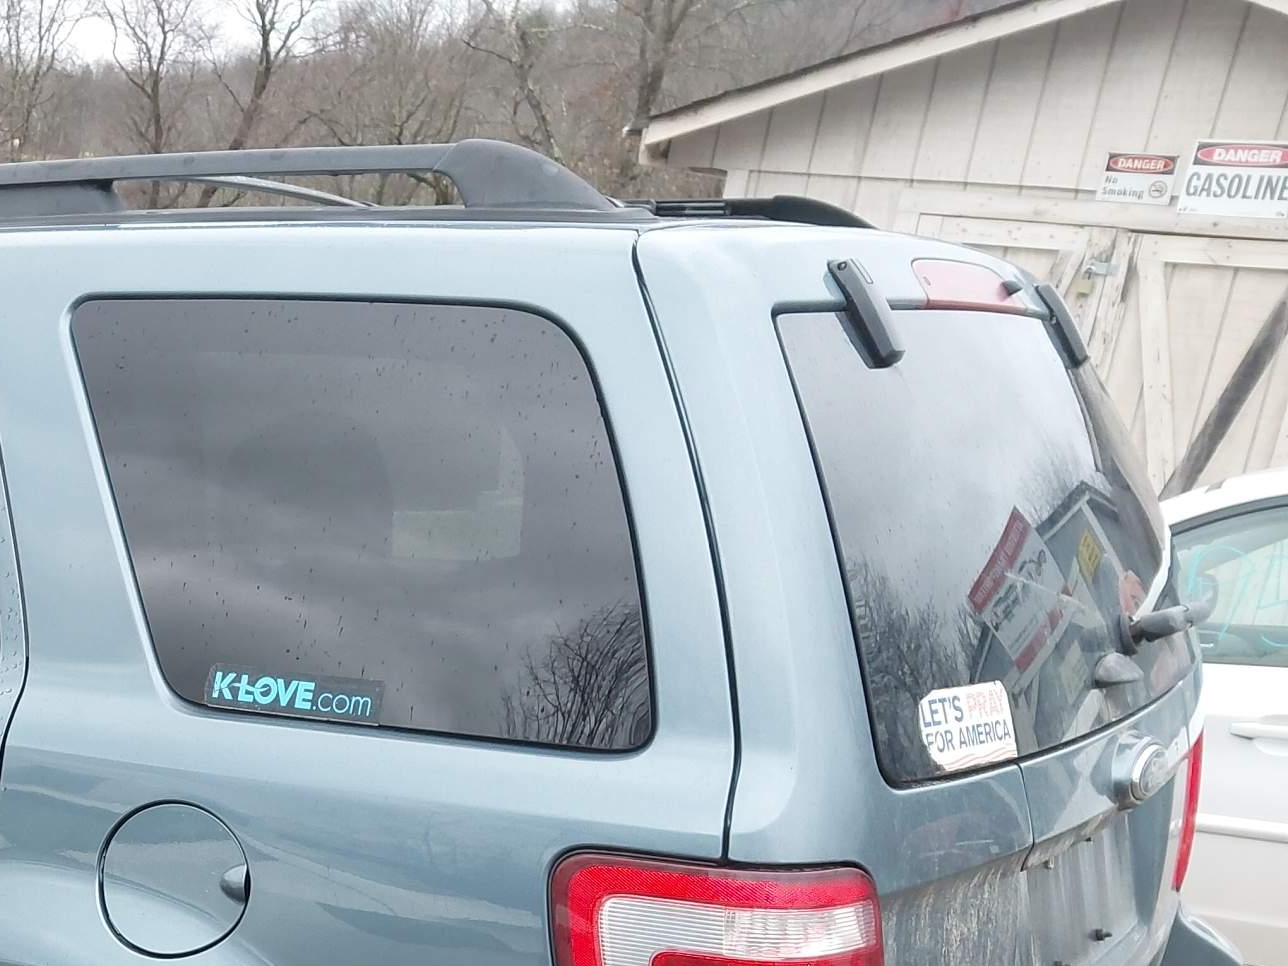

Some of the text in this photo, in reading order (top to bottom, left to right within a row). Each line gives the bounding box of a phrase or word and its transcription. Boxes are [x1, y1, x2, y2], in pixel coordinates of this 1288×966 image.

[1212, 148, 1282, 163] DANGER
[1117, 158, 1165, 170] DANGER
[1105, 175, 1119, 184] No
[1185, 171, 1288, 201] GASOLINE
[1101, 186, 1144, 200] Smoking
[920, 688, 1004, 728] LET'S PRAY
[925, 719, 1011, 753] FOR AMERICA
